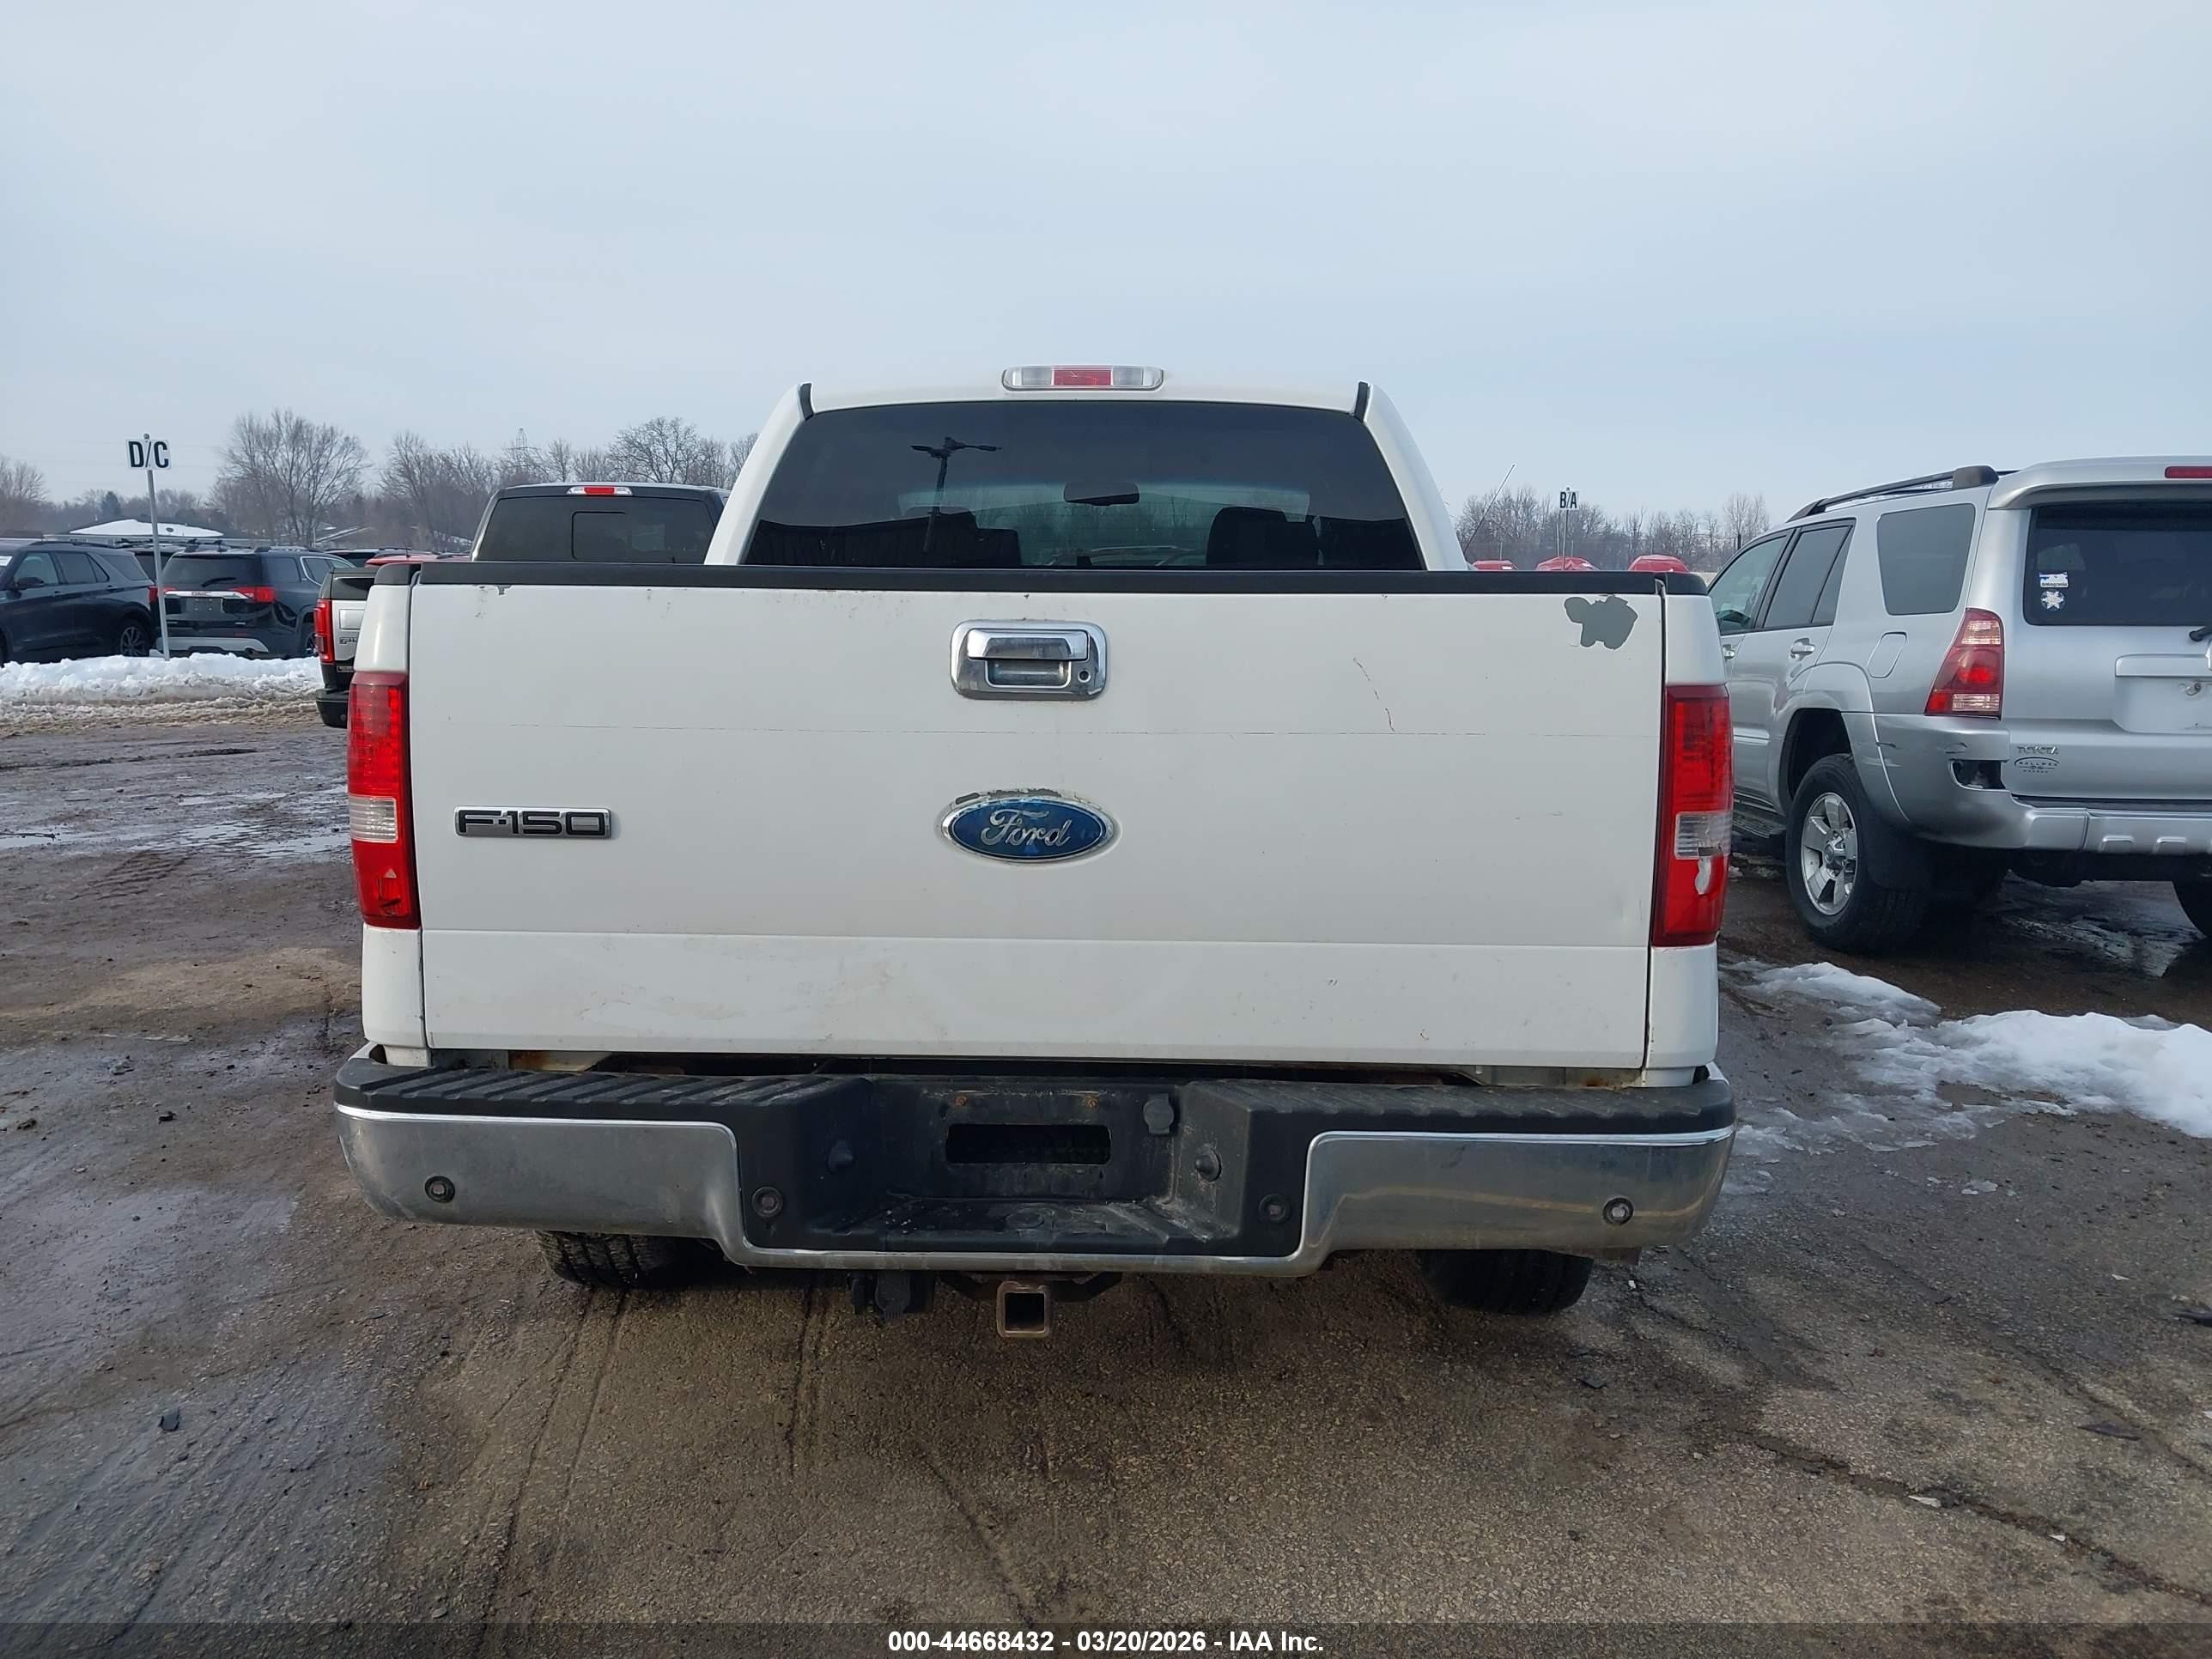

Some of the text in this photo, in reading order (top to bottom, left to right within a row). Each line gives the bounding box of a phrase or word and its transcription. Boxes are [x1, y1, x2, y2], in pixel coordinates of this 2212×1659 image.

[128, 441, 169, 469] D/C
[1559, 491, 1577, 509] B/A
[458, 810, 606, 836] F-150
[980, 808, 1073, 847] Ford
